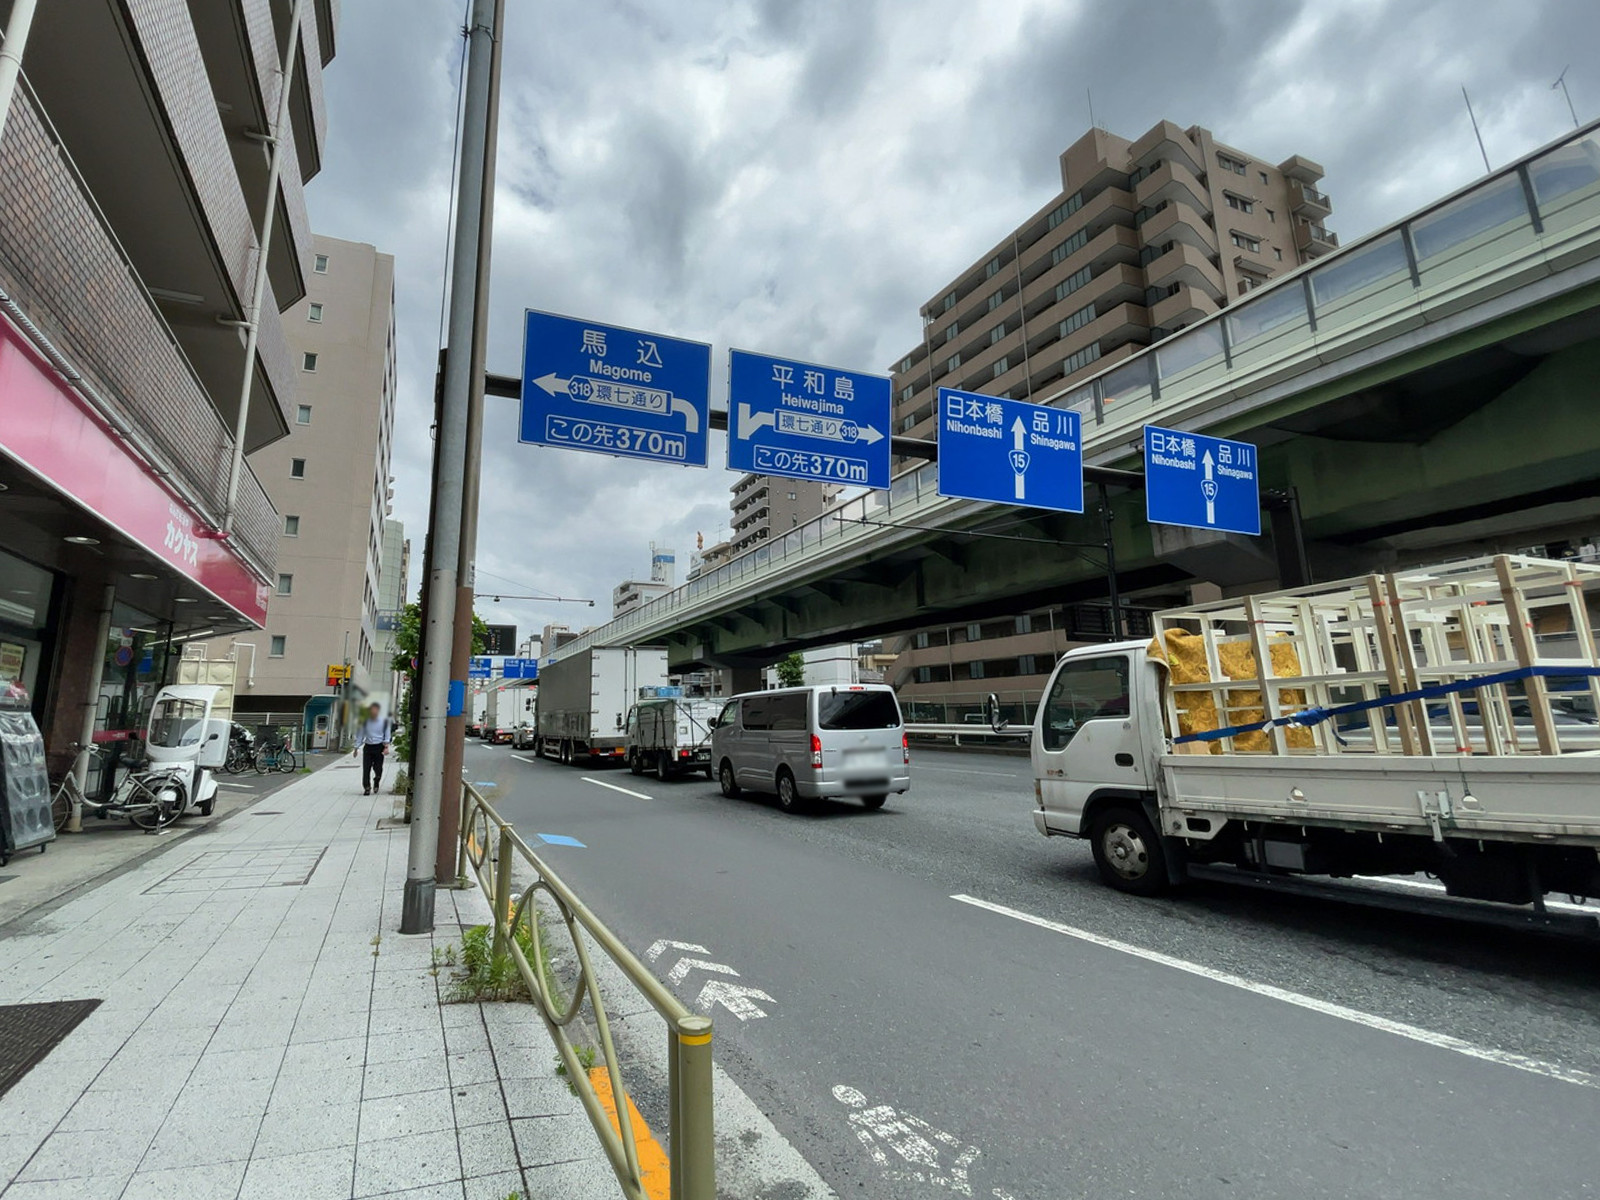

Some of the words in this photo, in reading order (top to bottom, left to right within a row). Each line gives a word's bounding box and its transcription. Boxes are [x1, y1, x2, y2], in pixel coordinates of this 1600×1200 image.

[581, 329, 663, 368] 馬込
[589, 360, 652, 383] Magome
[772, 365, 855, 401] 平和島
[571, 379, 593, 398] 318
[595, 383, 664, 410] 環七通り
[782, 393, 844, 415] Heiwajima
[947, 396, 1003, 426] 日本橋
[781, 415, 838, 437] 環七通り
[841, 425, 857, 439] 318
[947, 419, 1003, 440] Nihonbashi
[1033, 411, 1073, 437] 品川
[550, 419, 684, 458] この先370m
[1030, 433, 1076, 451] Shinagawa
[1151, 433, 1196, 458] 日本橋
[757, 448, 866, 481] この先370m
[1012, 454, 1025, 467] 15
[1151, 454, 1196, 471] Nihonbashi
[1218, 445, 1250, 467] 品川
[1217, 464, 1253, 480] Shinagawa
[1204, 483, 1214, 495] 15
[164, 520, 198, 568] カクヤス
